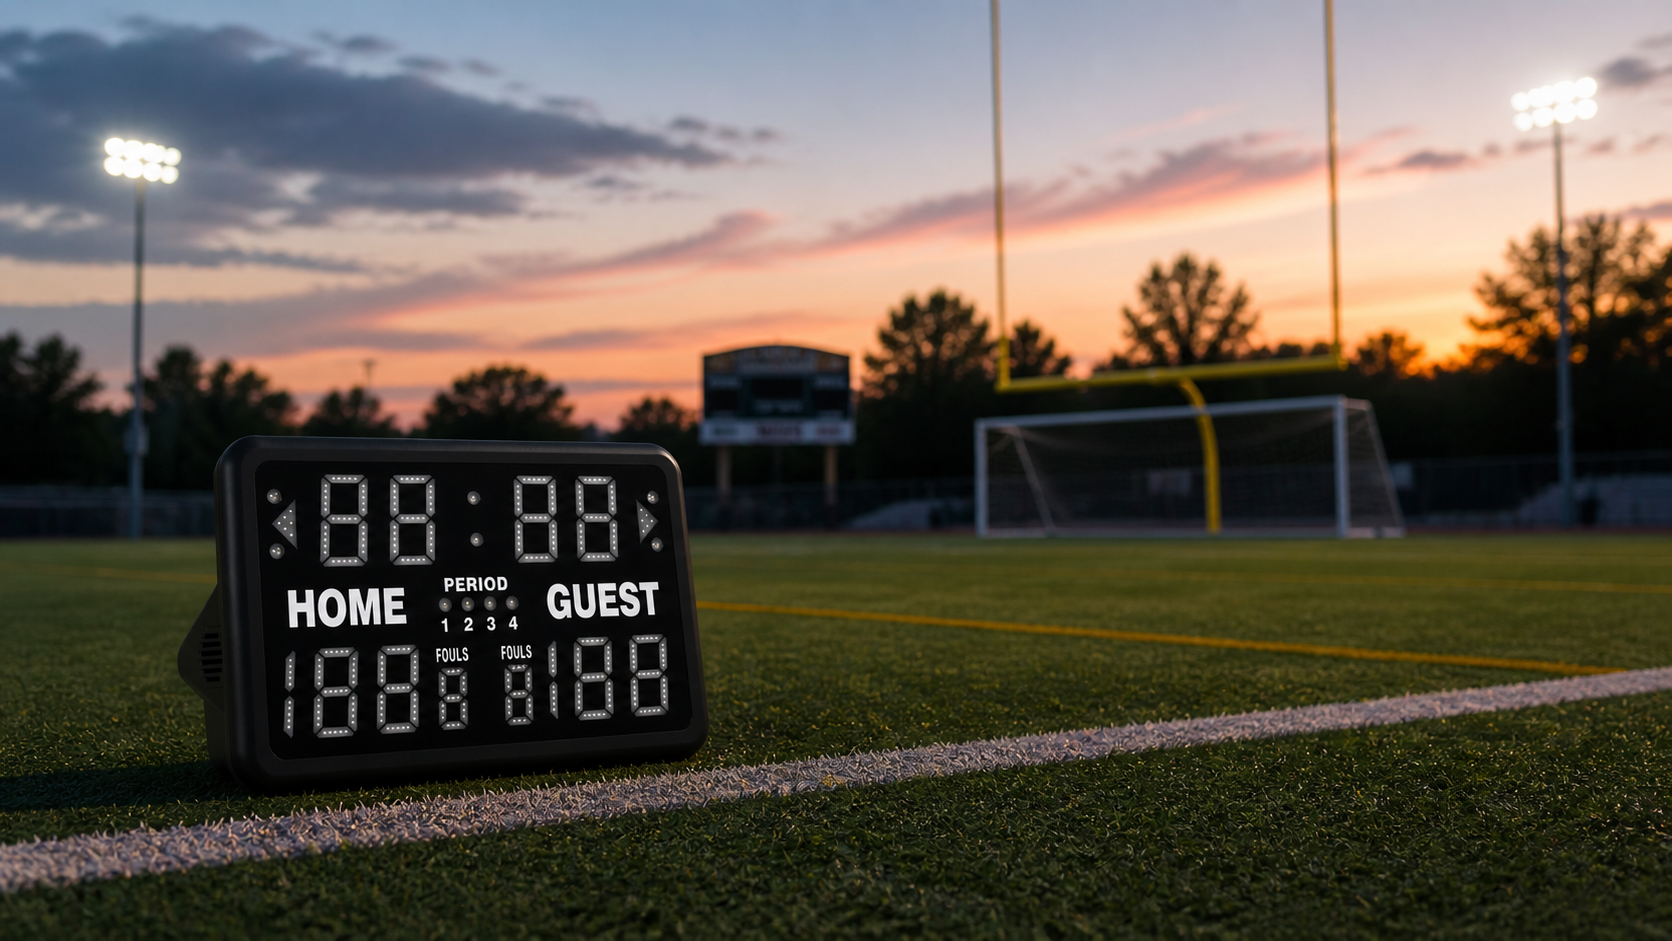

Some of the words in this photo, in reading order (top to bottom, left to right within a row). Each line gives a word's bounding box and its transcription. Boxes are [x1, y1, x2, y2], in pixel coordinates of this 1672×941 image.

[443, 576, 509, 593] PERIOD
[287, 586, 408, 629] HOME
[546, 581, 660, 620] GUEST
[440, 617, 449, 633] 1
[463, 616, 474, 632] 2
[486, 616, 497, 632] 3
[508, 615, 519, 631] 4
[435, 646, 470, 663] FOULS
[500, 644, 533, 661] FOULS
